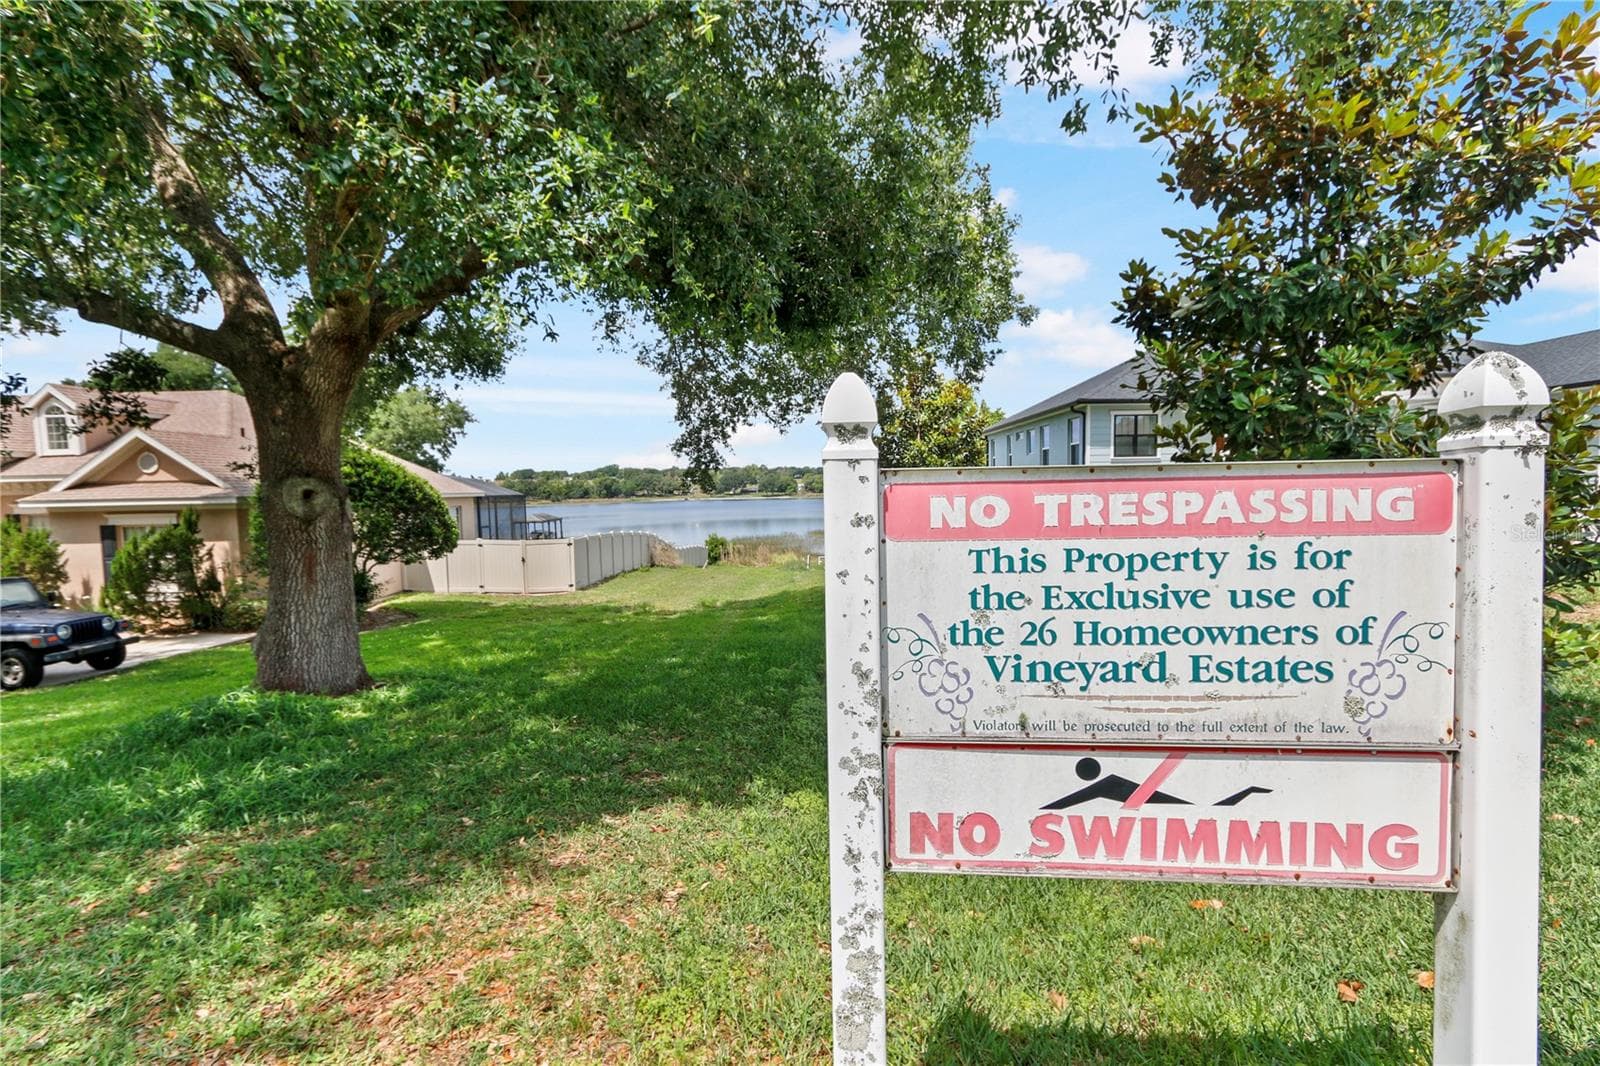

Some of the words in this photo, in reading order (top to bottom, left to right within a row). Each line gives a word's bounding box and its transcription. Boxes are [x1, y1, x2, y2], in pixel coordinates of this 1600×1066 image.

[929, 495, 1010, 529] NO
[1034, 487, 1415, 527] TRESPASSING
[968, 546, 1047, 574] This
[1063, 544, 1230, 580] Property
[1247, 544, 1277, 571] is
[1294, 541, 1352, 570] for
[968, 583, 1026, 611] the
[1041, 581, 1211, 611] Exclusive
[1228, 588, 1296, 609] use
[1312, 579, 1354, 608] of
[947, 619, 1004, 647] the
[1020, 616, 1058, 646] 26
[1073, 620, 1319, 646] Homeowners
[1335, 616, 1378, 646] of
[984, 650, 1169, 691] Vineyard
[1188, 654, 1335, 684] Estates
[1032, 719, 1056, 732] will
[1063, 719, 1078, 732] be
[1084, 719, 1150, 734] prosecuted
[1157, 721, 1169, 733] to
[1175, 720, 1196, 733] the
[1202, 720, 1223, 733] full
[1229, 721, 1268, 734] extent
[1274, 720, 1288, 734] of
[1294, 721, 1315, 734] the
[1321, 721, 1350, 734] law.
[909, 811, 1001, 856] NO
[1028, 812, 1420, 871] SWIMMING
